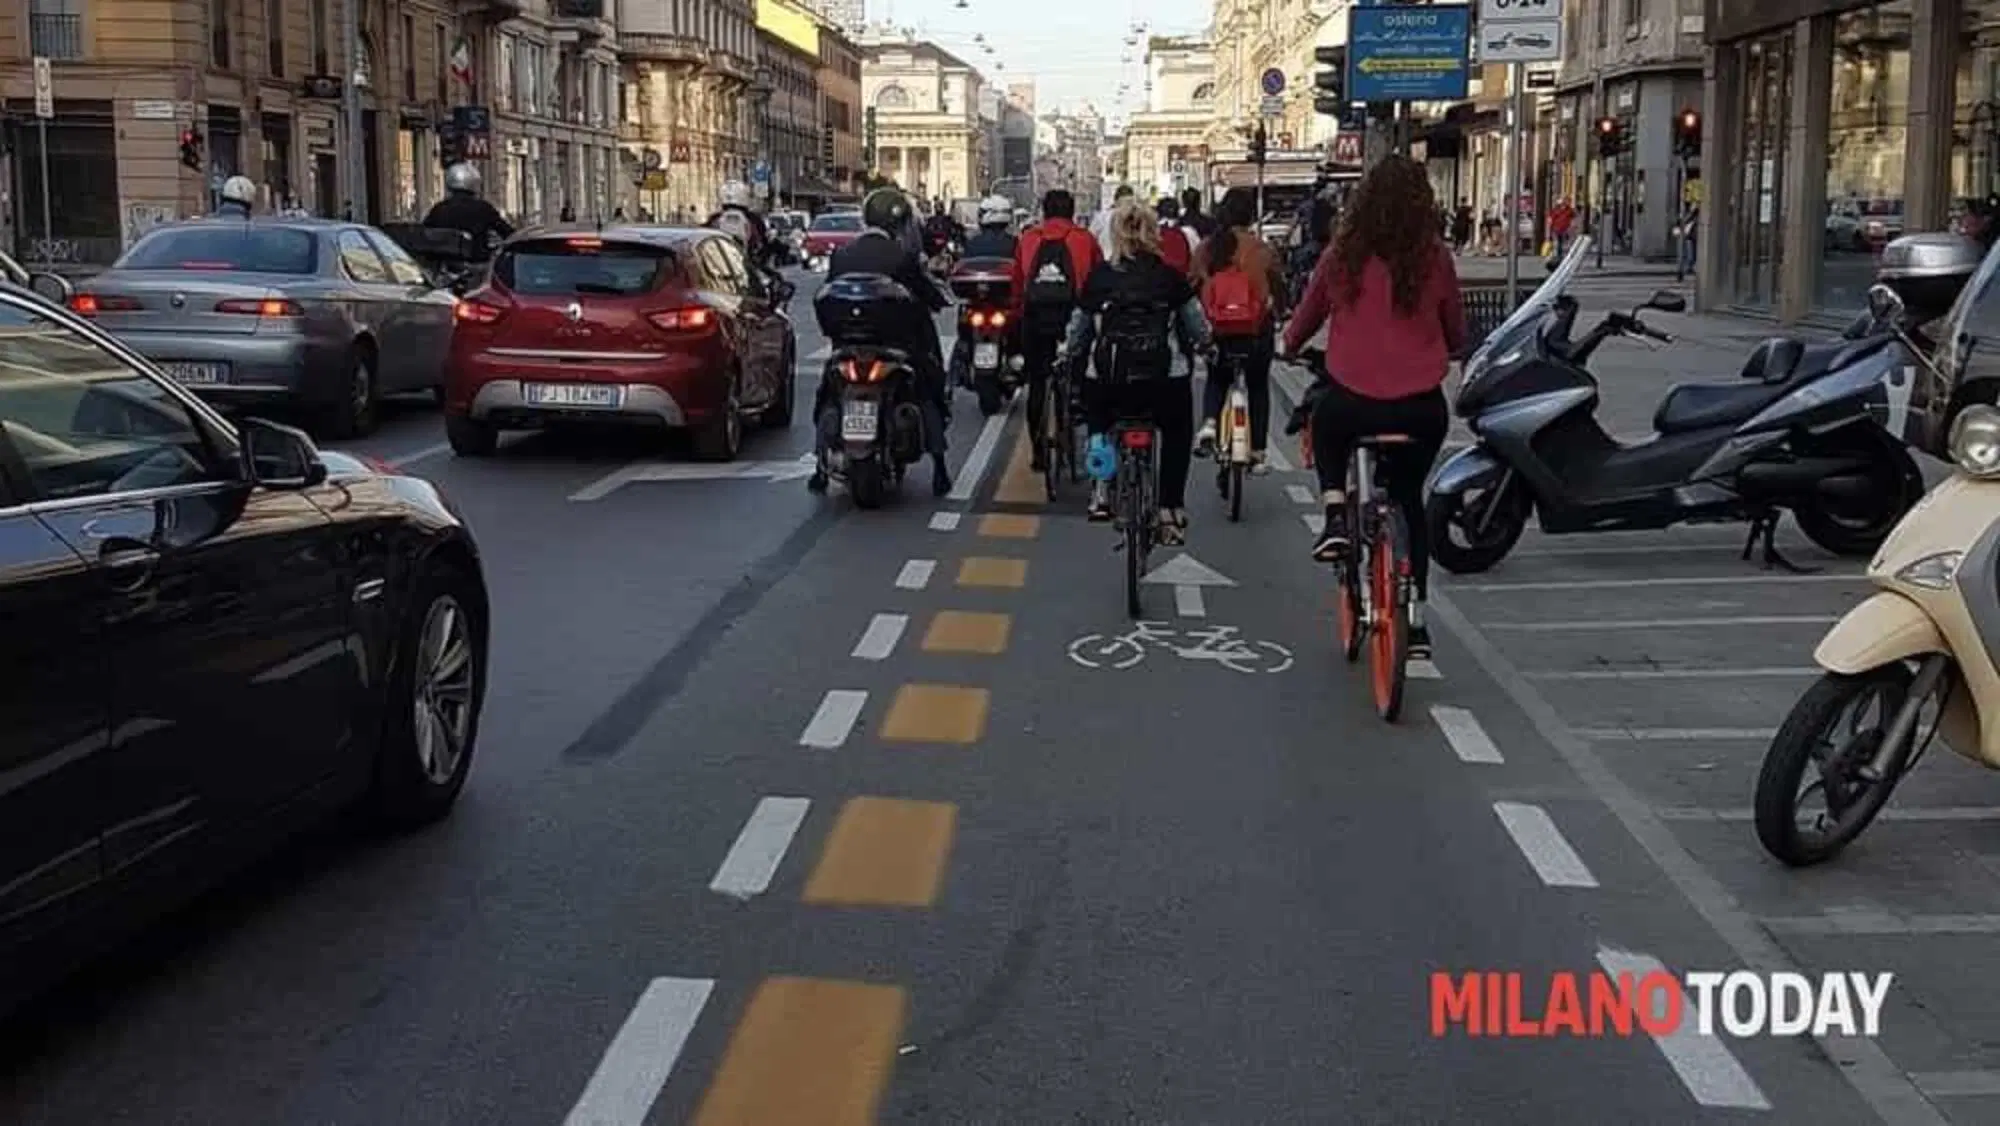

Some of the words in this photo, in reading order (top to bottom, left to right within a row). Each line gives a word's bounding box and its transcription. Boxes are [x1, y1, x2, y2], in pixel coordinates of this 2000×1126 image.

[1384, 12, 1438, 27] osteria
[467, 135, 489, 154] M
[673, 145, 689, 160] M
[1338, 137, 1359, 156] M
